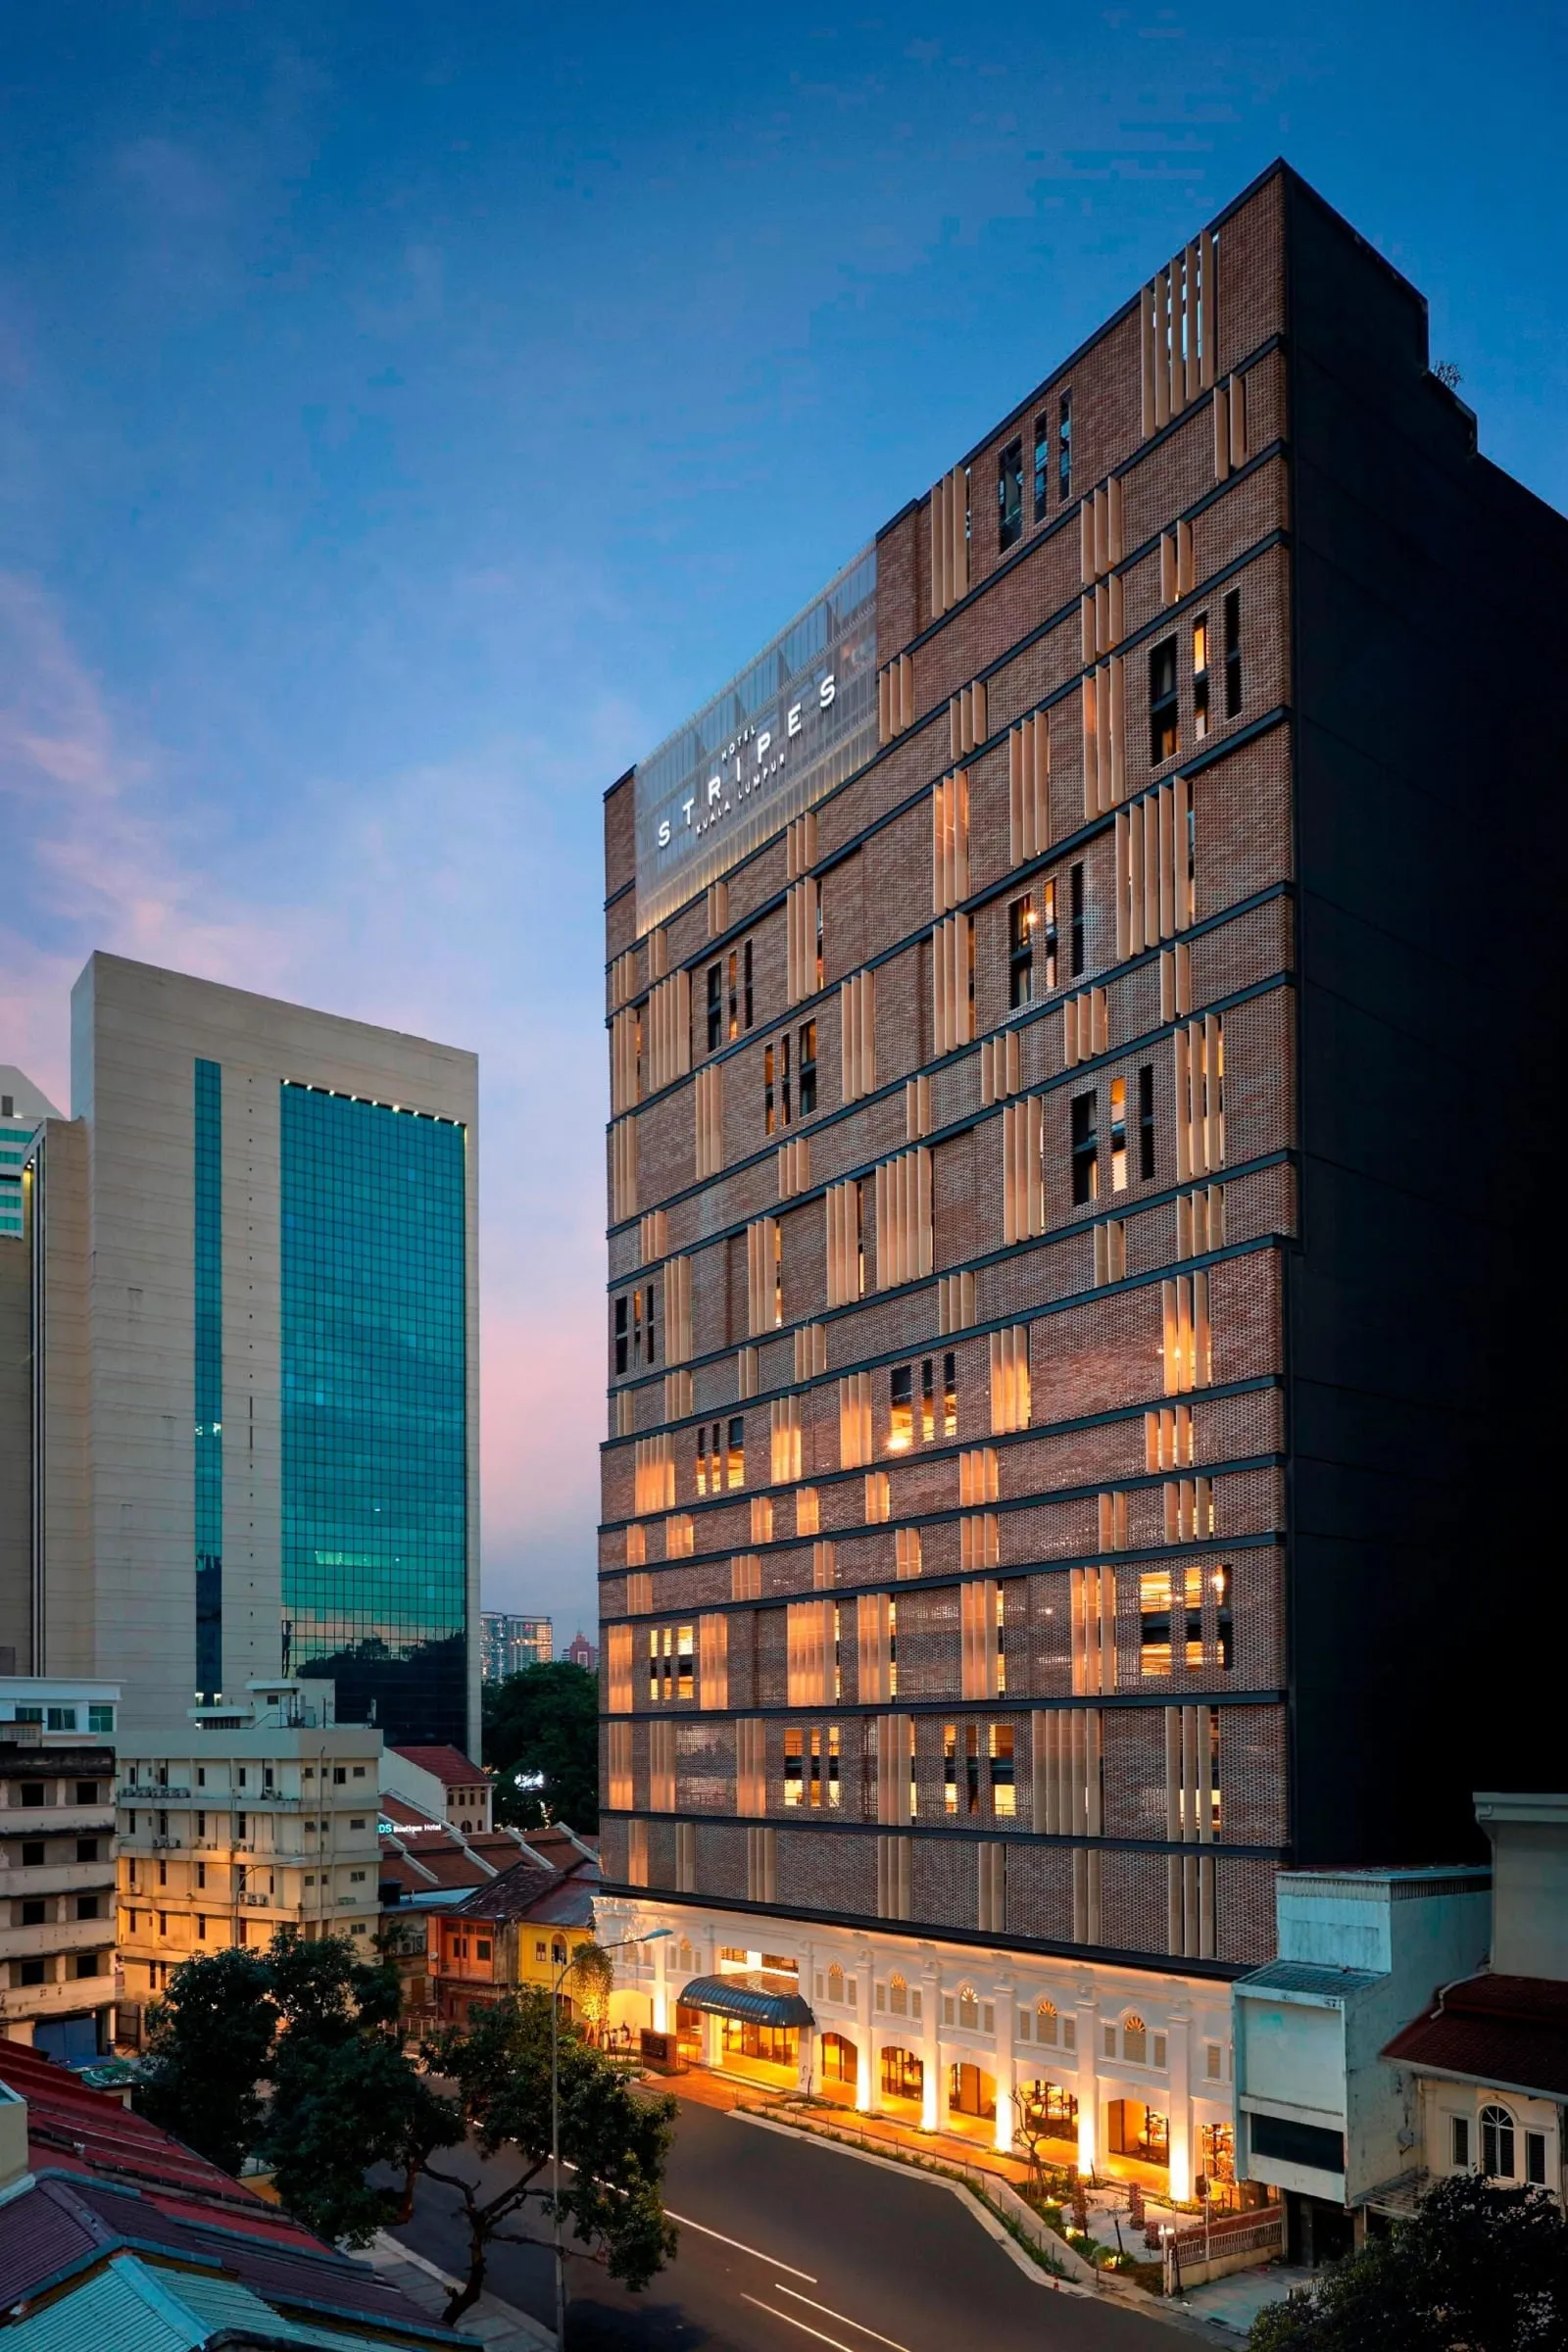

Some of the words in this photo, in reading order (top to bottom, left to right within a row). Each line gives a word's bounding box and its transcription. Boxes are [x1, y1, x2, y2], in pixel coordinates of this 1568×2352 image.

[658, 674, 836, 848] STRIPES
[721, 725, 756, 761] HOTEL
[696, 800, 731, 834] KUALA
[738, 752, 785, 800] LUMPUR
[378, 1824, 392, 1834] DS
